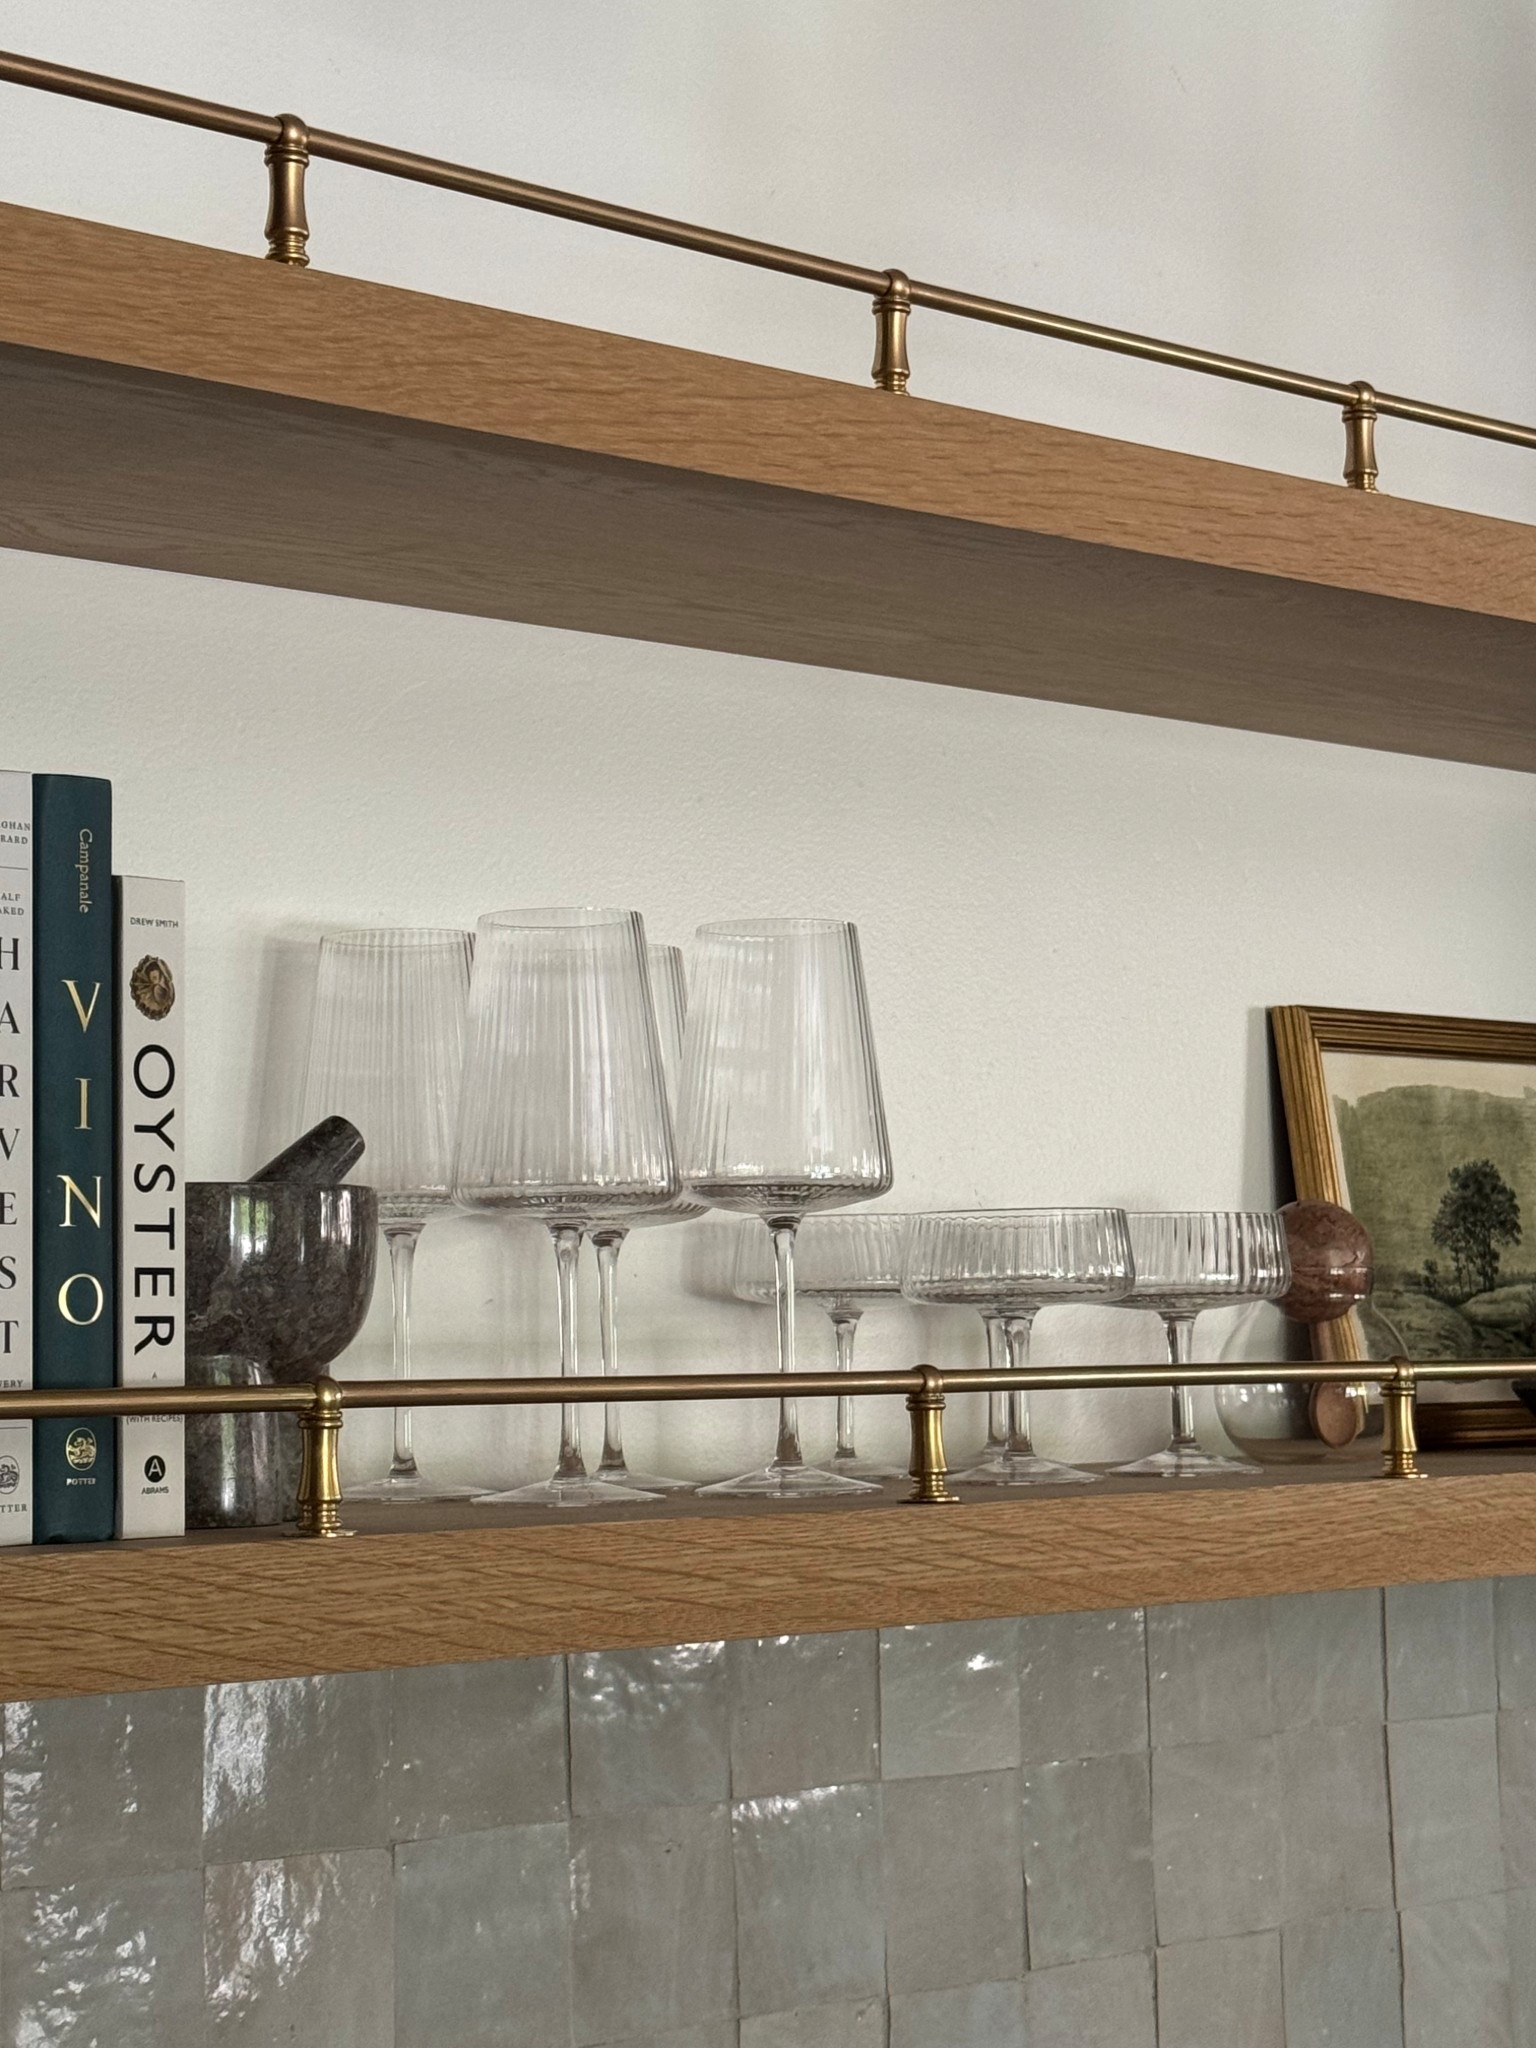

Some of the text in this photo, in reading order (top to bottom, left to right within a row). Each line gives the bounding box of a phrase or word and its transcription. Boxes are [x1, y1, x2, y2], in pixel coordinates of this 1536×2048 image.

[74, 828, 93, 914] Campanale
[130, 917, 179, 928] DREW SMITH
[57, 979, 104, 1326] VINO
[133, 1044, 176, 1356] OYSTER
[66, 1477, 96, 1486] POTTER
[141, 1486, 170, 1495] ABRAMS
